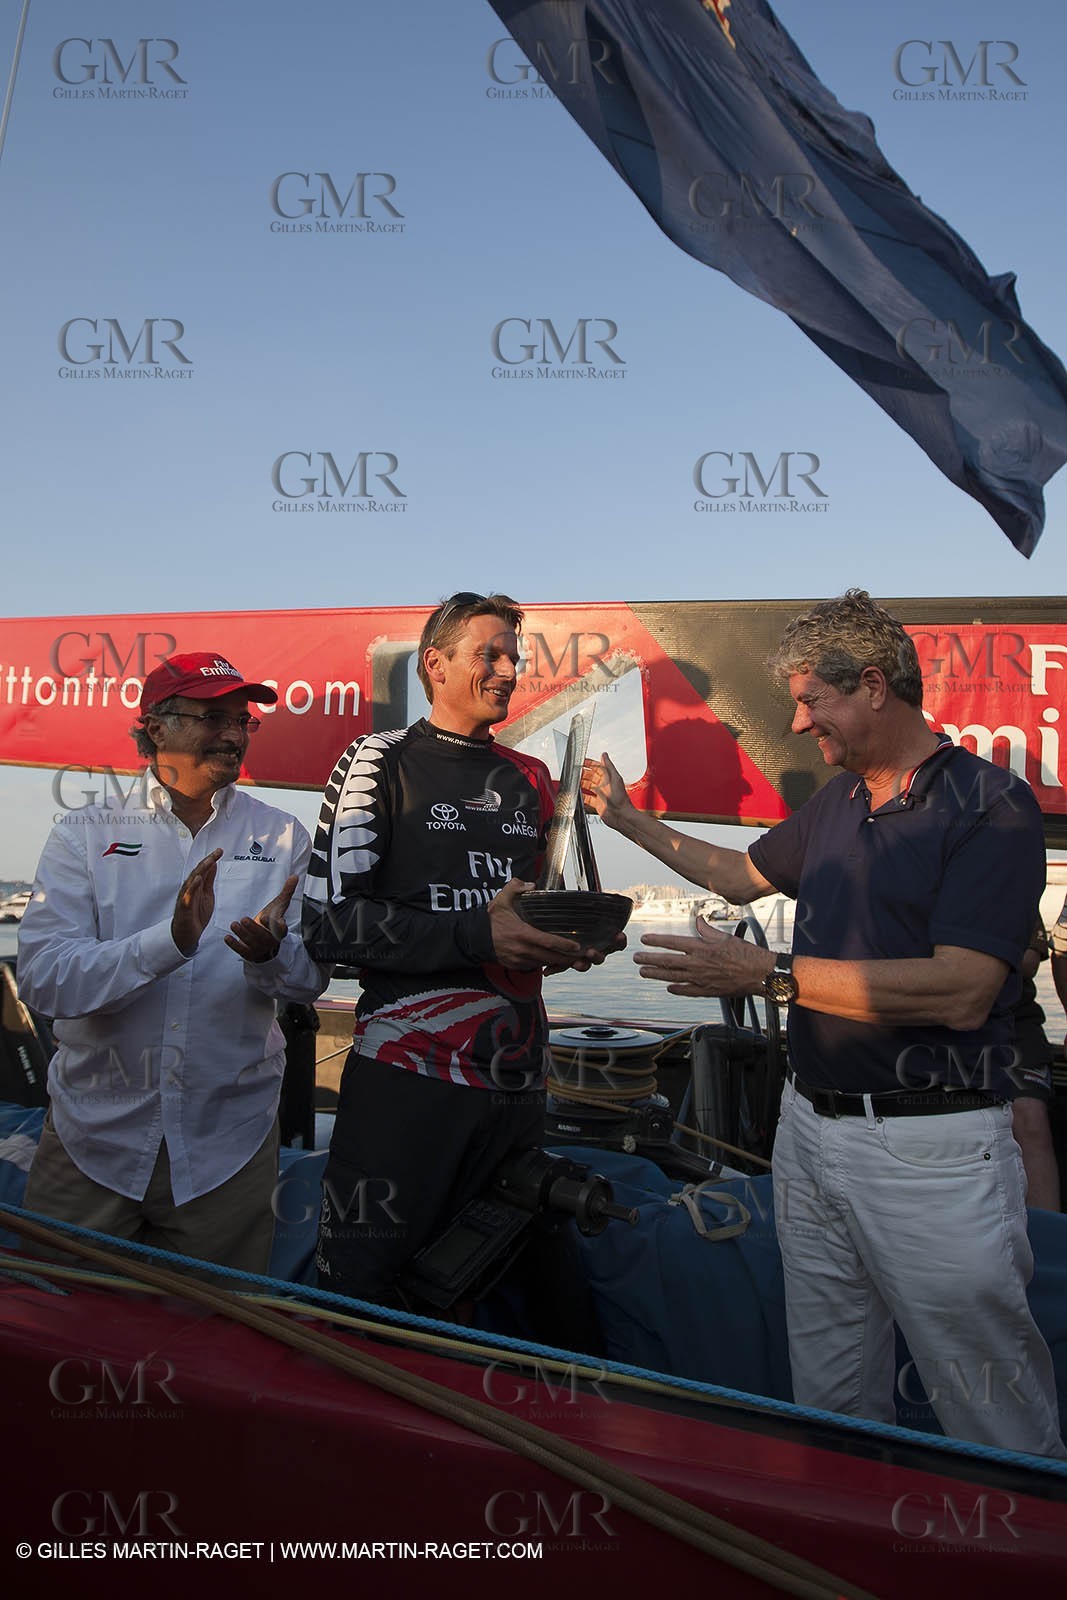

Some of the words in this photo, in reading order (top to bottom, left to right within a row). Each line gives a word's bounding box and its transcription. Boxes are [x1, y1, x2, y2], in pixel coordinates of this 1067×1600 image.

[922, 707, 1063, 787] mi
[426, 821, 467, 831] TOYOTA
[501, 823, 538, 838] OMEGA
[467, 851, 513, 883] Fly
